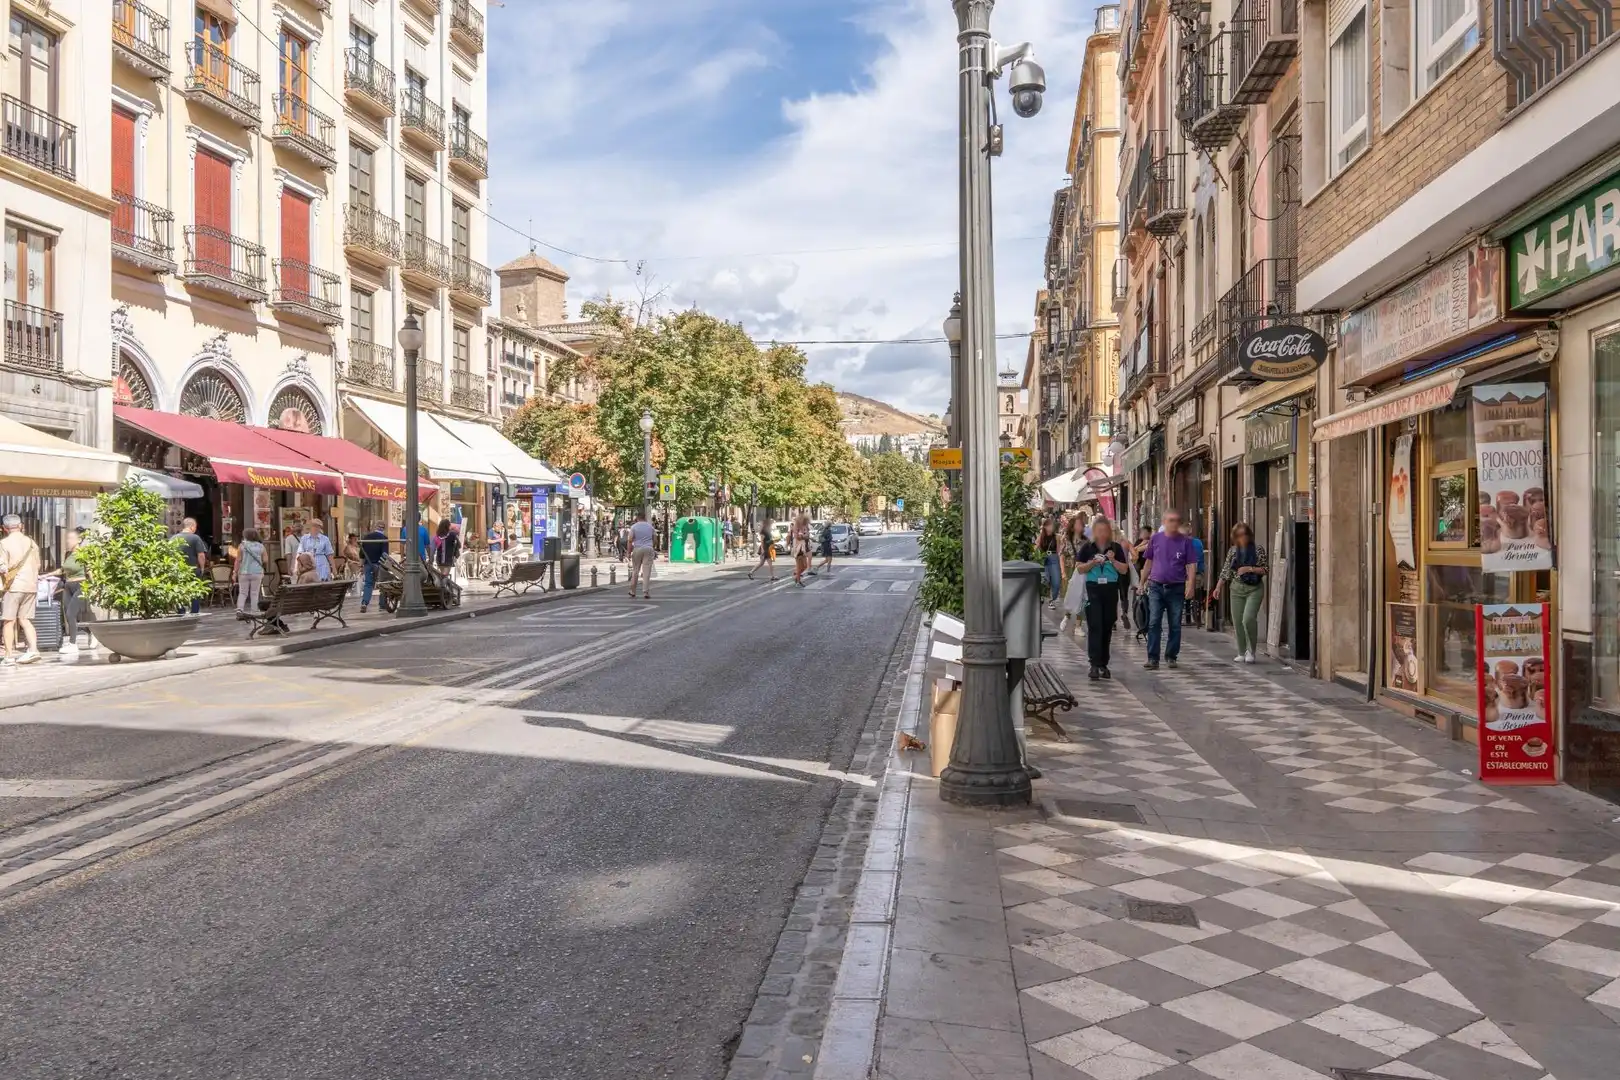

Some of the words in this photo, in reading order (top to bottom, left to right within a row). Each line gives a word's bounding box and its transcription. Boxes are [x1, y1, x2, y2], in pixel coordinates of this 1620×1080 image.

[1551, 189, 1620, 279] FAR
[1253, 420, 1289, 450] GRANART
[1482, 450, 1543, 468] PIONONOS
[1482, 469, 1494, 481] DE
[1499, 467, 1528, 480] SANTA
[1533, 467, 1543, 479] FE
[1486, 761, 1548, 770] ESTABLECIMIENTO
